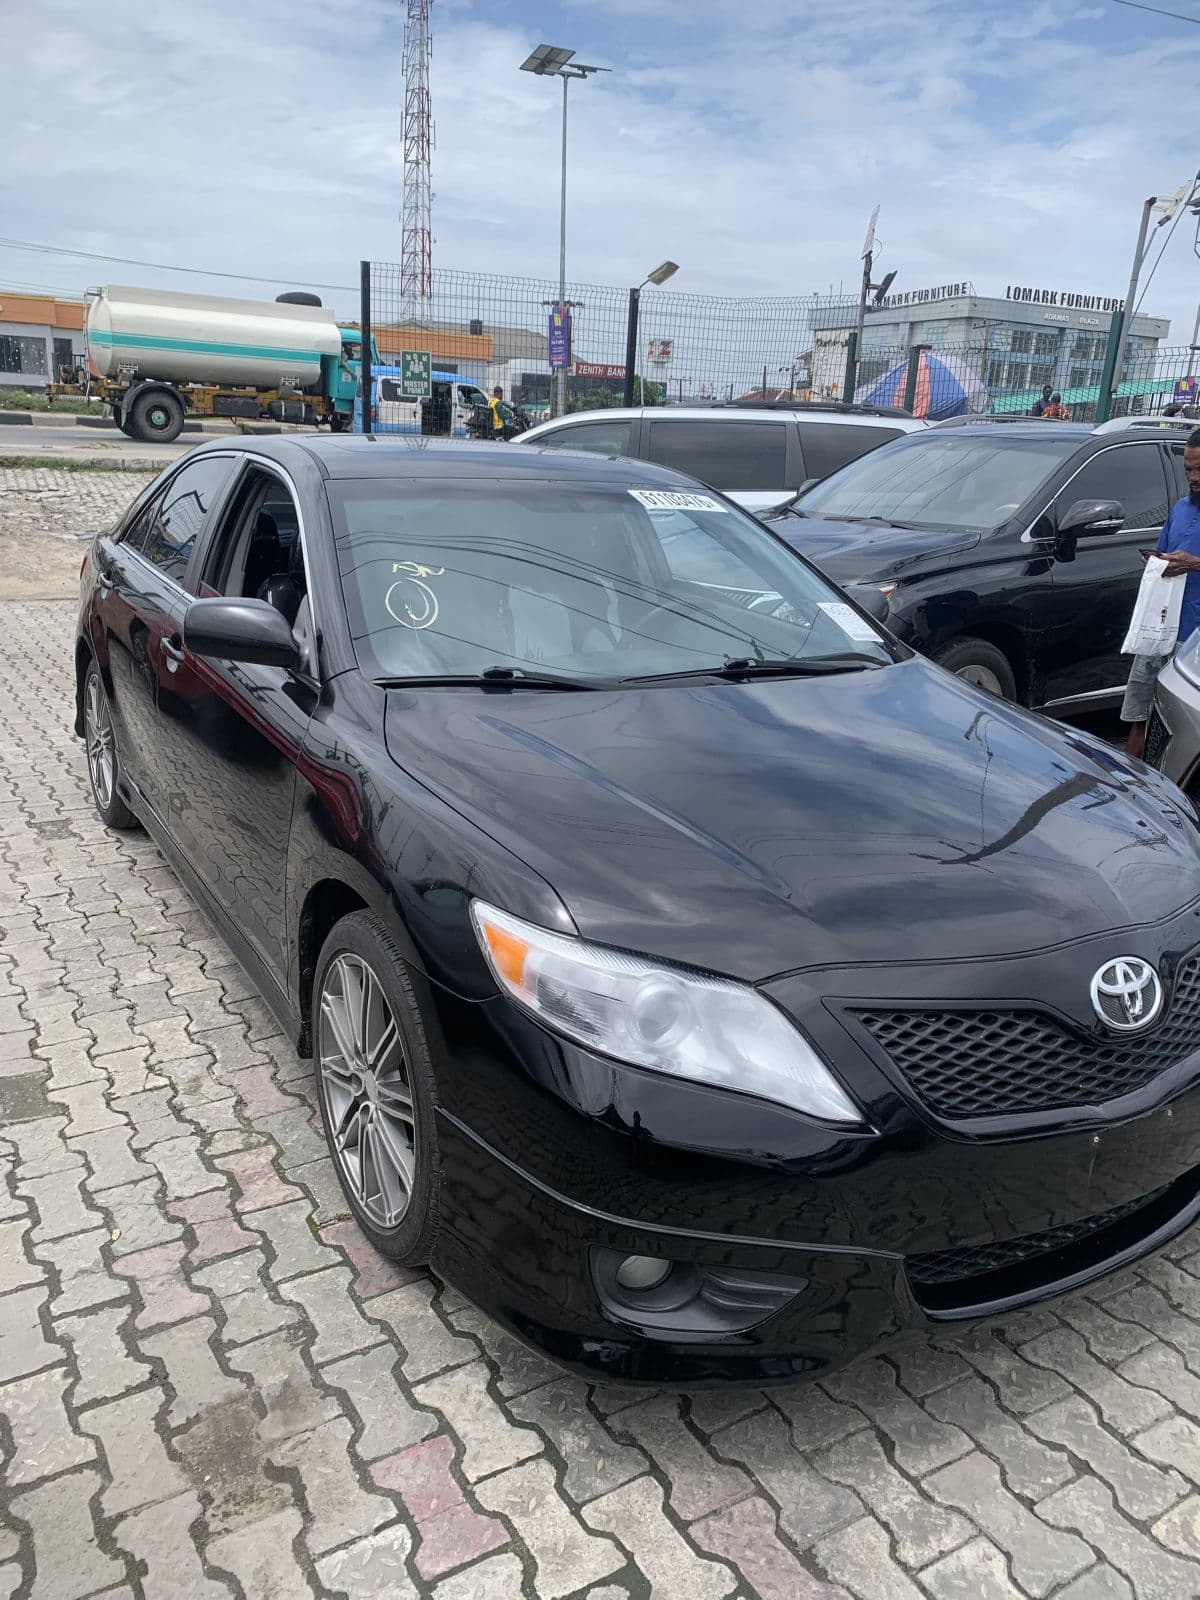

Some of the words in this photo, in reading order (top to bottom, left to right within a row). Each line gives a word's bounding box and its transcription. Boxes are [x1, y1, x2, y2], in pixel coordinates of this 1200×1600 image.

[911, 282, 968, 302] FURNITURE
[1006, 285, 1058, 305] LOMARK
[1060, 292, 1125, 312] FURNITURE
[1079, 317, 1100, 326] PLAZA
[578, 364, 605, 375] ZENITH
[403, 380, 428, 388] MUSTER
